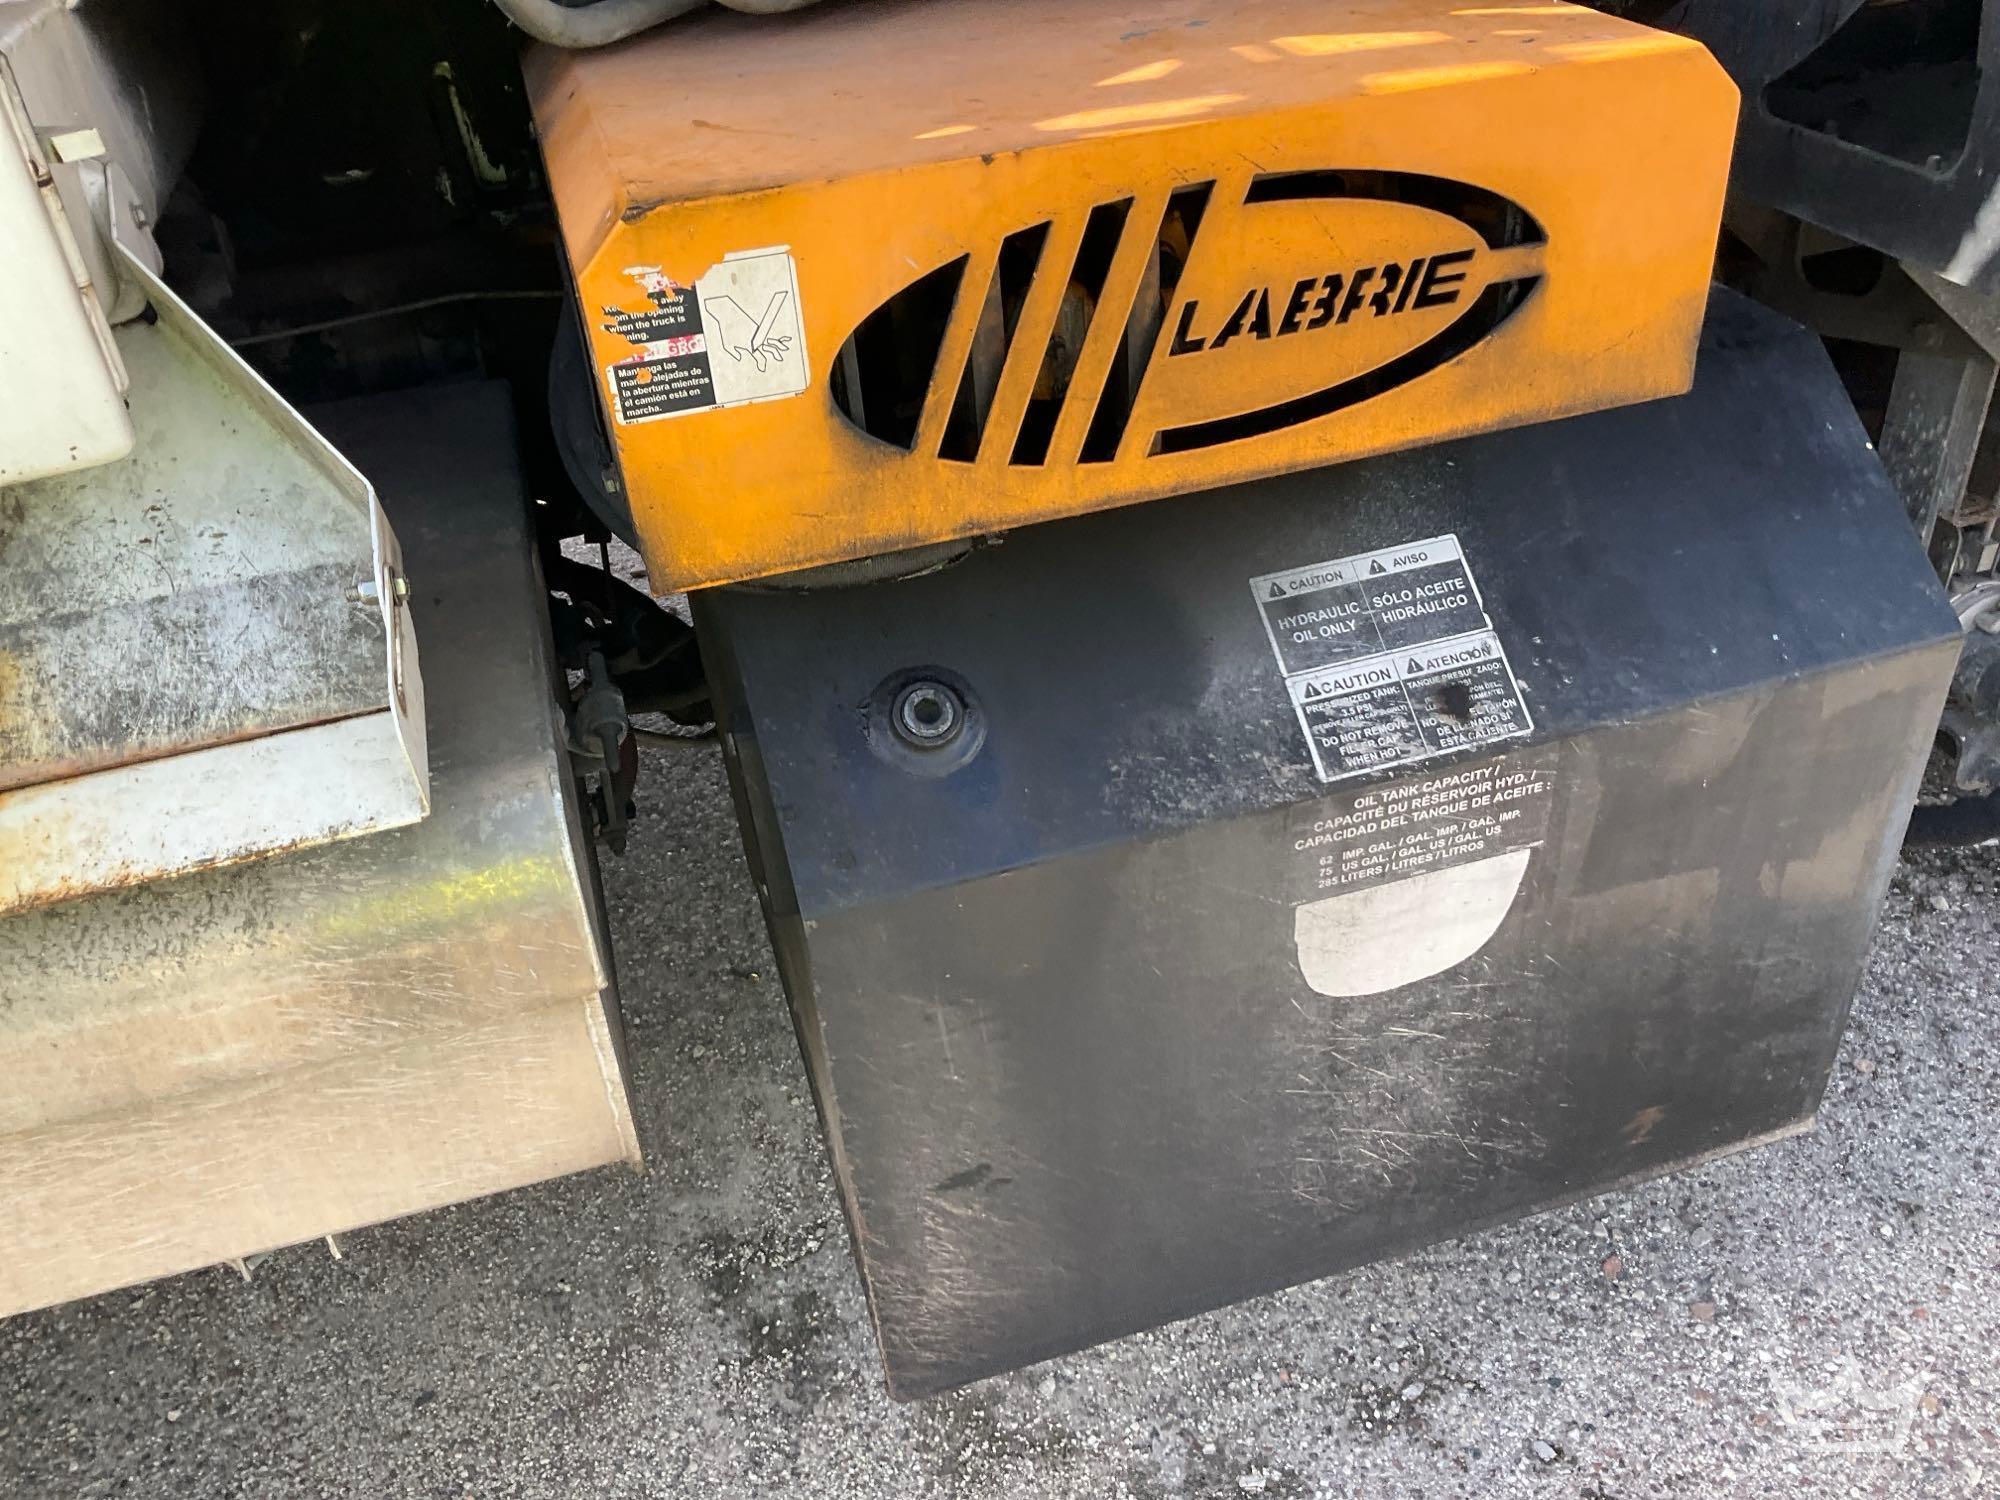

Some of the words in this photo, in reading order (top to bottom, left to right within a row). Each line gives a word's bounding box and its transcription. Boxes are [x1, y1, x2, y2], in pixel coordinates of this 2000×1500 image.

[647, 304, 684, 318] opening
[1168, 249, 1476, 357] LABRIE
[609, 322, 634, 334] when
[636, 320, 650, 330] the
[652, 316, 676, 326] truck
[678, 314, 686, 322] is
[653, 370, 688, 382] alejadas
[690, 367, 702, 376] de
[664, 362, 677, 370] las
[622, 388, 631, 398] la
[633, 383, 670, 396] abertura
[672, 376, 710, 389] mientras
[624, 398, 634, 408] el
[634, 393, 668, 405] camión
[669, 390, 688, 400] está
[689, 388, 700, 396] en
[626, 405, 662, 417] marcha.
[1393, 552, 1428, 568] AVISO
[1289, 571, 1344, 591] CAUTION
[1372, 589, 1412, 608] SÓLO
[1415, 577, 1466, 598] ACEITE
[1278, 602, 1360, 630] HYDRAULIC
[1381, 594, 1468, 624] HIDRÁULICO
[1293, 628, 1318, 644] OIL
[1320, 620, 1358, 638] ONLY
[1320, 668, 1392, 694] CAUTION
[1371, 685, 1401, 699] TANK:
[1357, 703, 1373, 715] PSI
[1322, 738, 1339, 748] DO
[1340, 730, 1362, 743] NOT
[1364, 718, 1409, 737] REMOVE
[1422, 718, 1437, 728] NO
[1345, 752, 1378, 767] WHEN
[1380, 746, 1402, 759] HOT
[1354, 796, 1378, 809] OIL
[1381, 784, 1419, 802] TANK
[1422, 766, 1492, 792] CAPACITY
[1314, 806, 1384, 832] CAPACITÉ
[1388, 801, 1408, 815] DU
[1411, 782, 1492, 810] RÉSERVOIR
[1494, 773, 1528, 790] HYD.
[1294, 822, 1378, 850] CAPACIDAD
[1380, 815, 1408, 830] DEL
[1411, 802, 1468, 822] TANQUE
[1471, 794, 1492, 809] DE
[1493, 782, 1544, 803] ACEITE
[1342, 848, 1365, 860] IMP.
[1368, 840, 1396, 854] GAL.
[1405, 830, 1434, 844] GAL.
[1436, 824, 1458, 837] IMP.
[1468, 816, 1496, 829] GAL.
[1499, 809, 1521, 822] IMP.
[1320, 866, 1333, 878] 75
[1342, 860, 1359, 872] US
[1361, 854, 1388, 867] GAL.
[1398, 844, 1426, 857] GAL.
[1430, 838, 1446, 850] US
[1454, 831, 1482, 844] GAL.
[1485, 825, 1502, 836] US
[1341, 865, 1383, 883] LITERS
[1392, 852, 1434, 870] LITRES
[1442, 841, 1484, 858] LITROS
